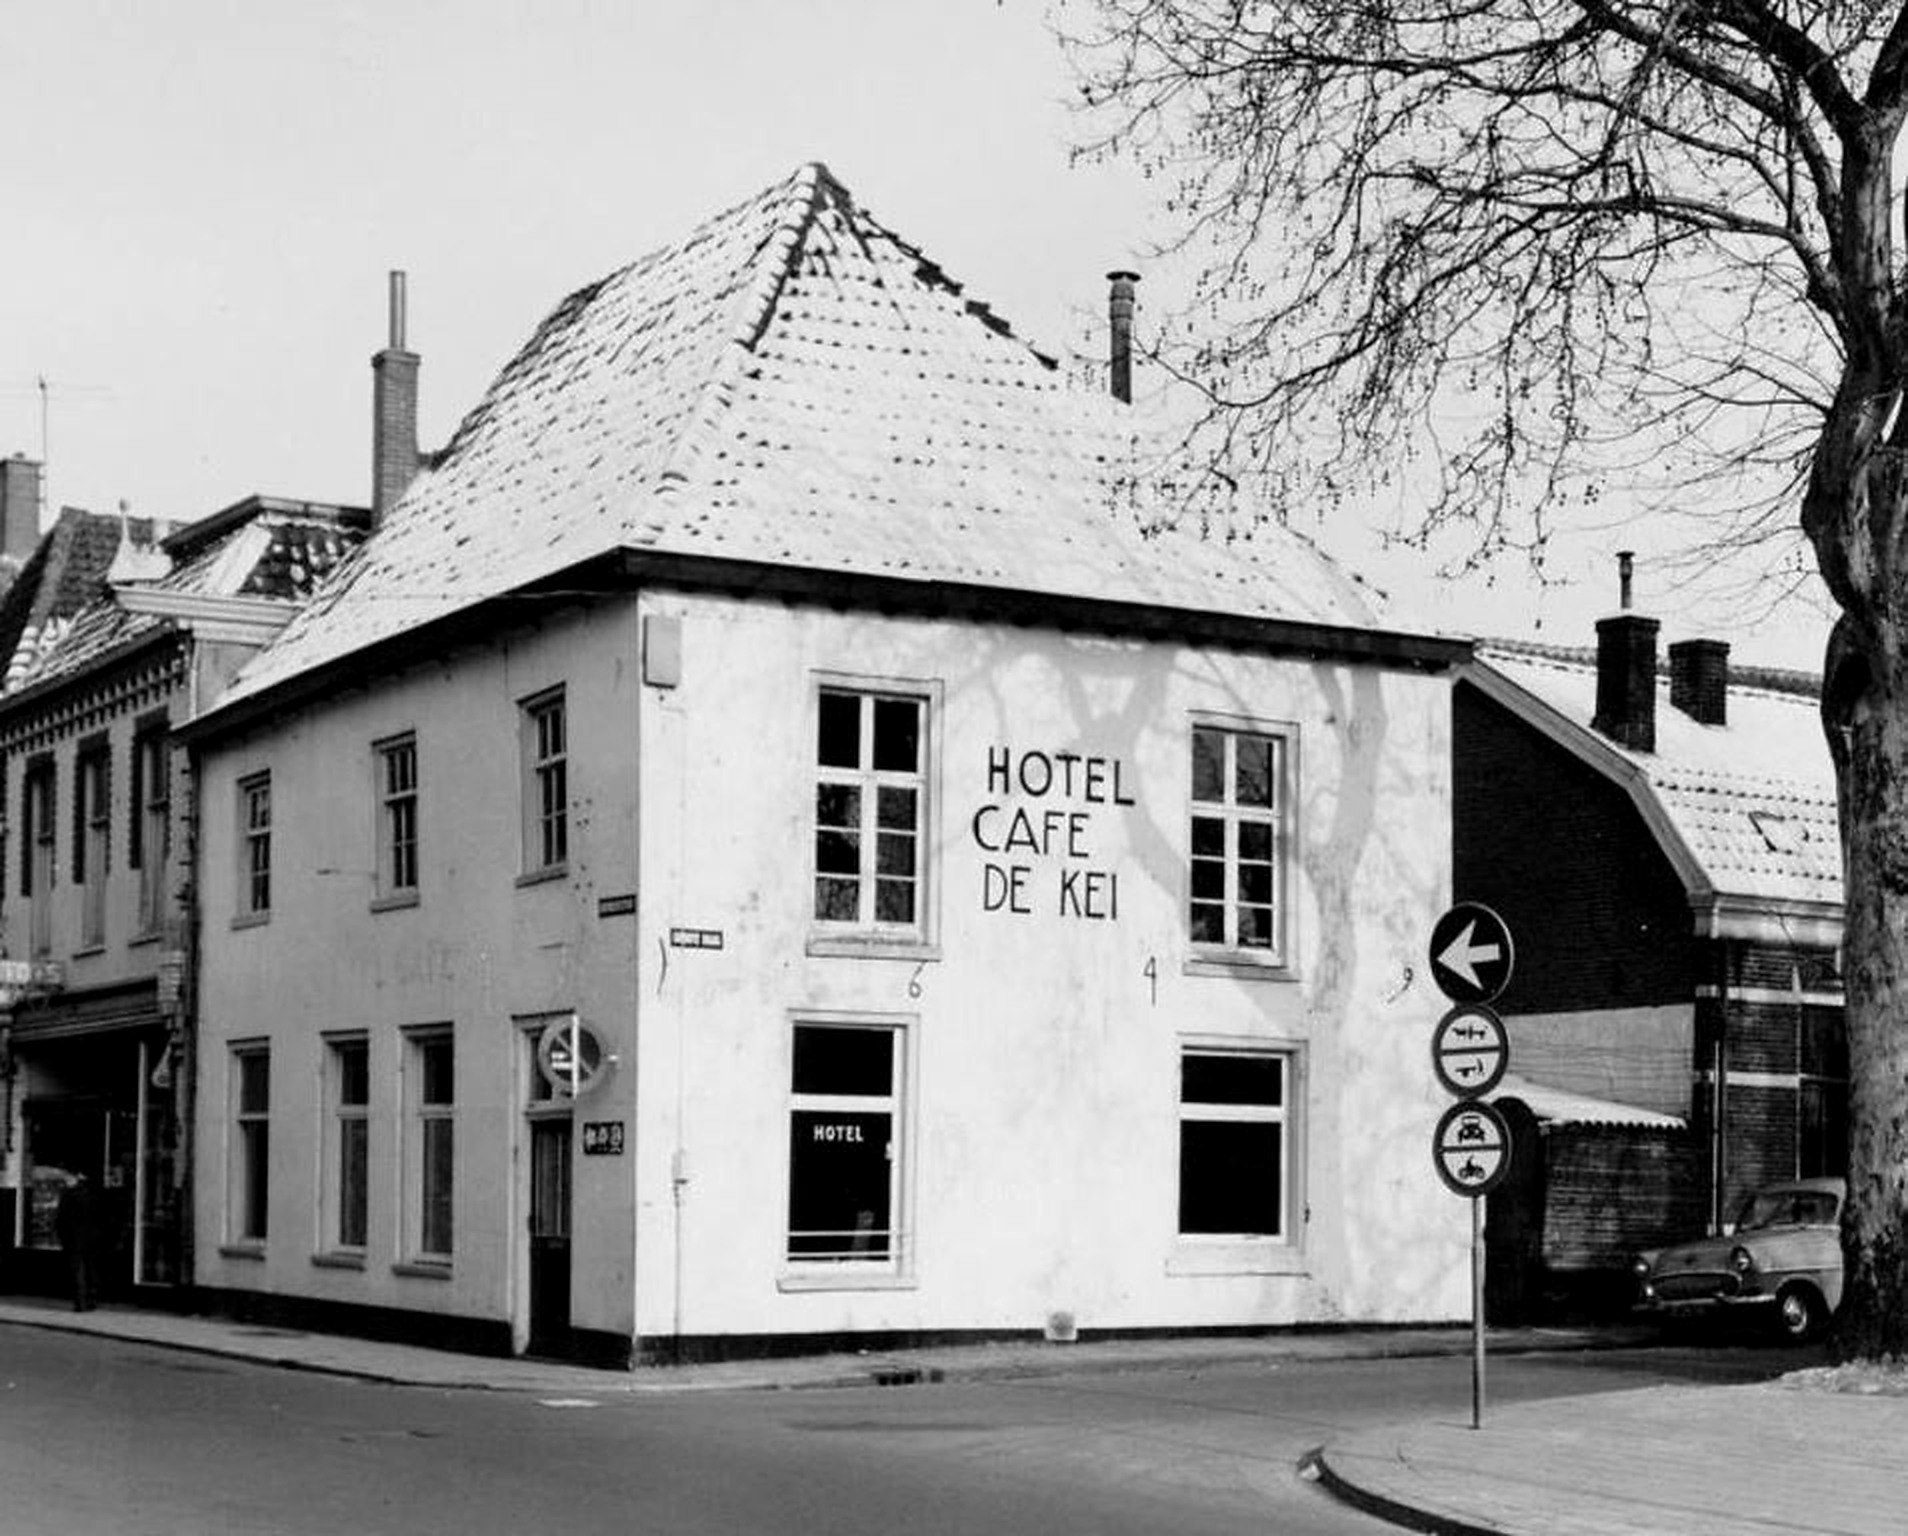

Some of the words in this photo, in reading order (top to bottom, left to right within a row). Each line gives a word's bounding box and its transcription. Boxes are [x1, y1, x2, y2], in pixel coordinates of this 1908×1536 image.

[988, 746, 1135, 806] HOTEL
[972, 805, 1090, 858] CAFE
[984, 864, 1031, 914] DE
[1060, 870, 1117, 920] KEI
[813, 1125, 864, 1142] HOTEL
